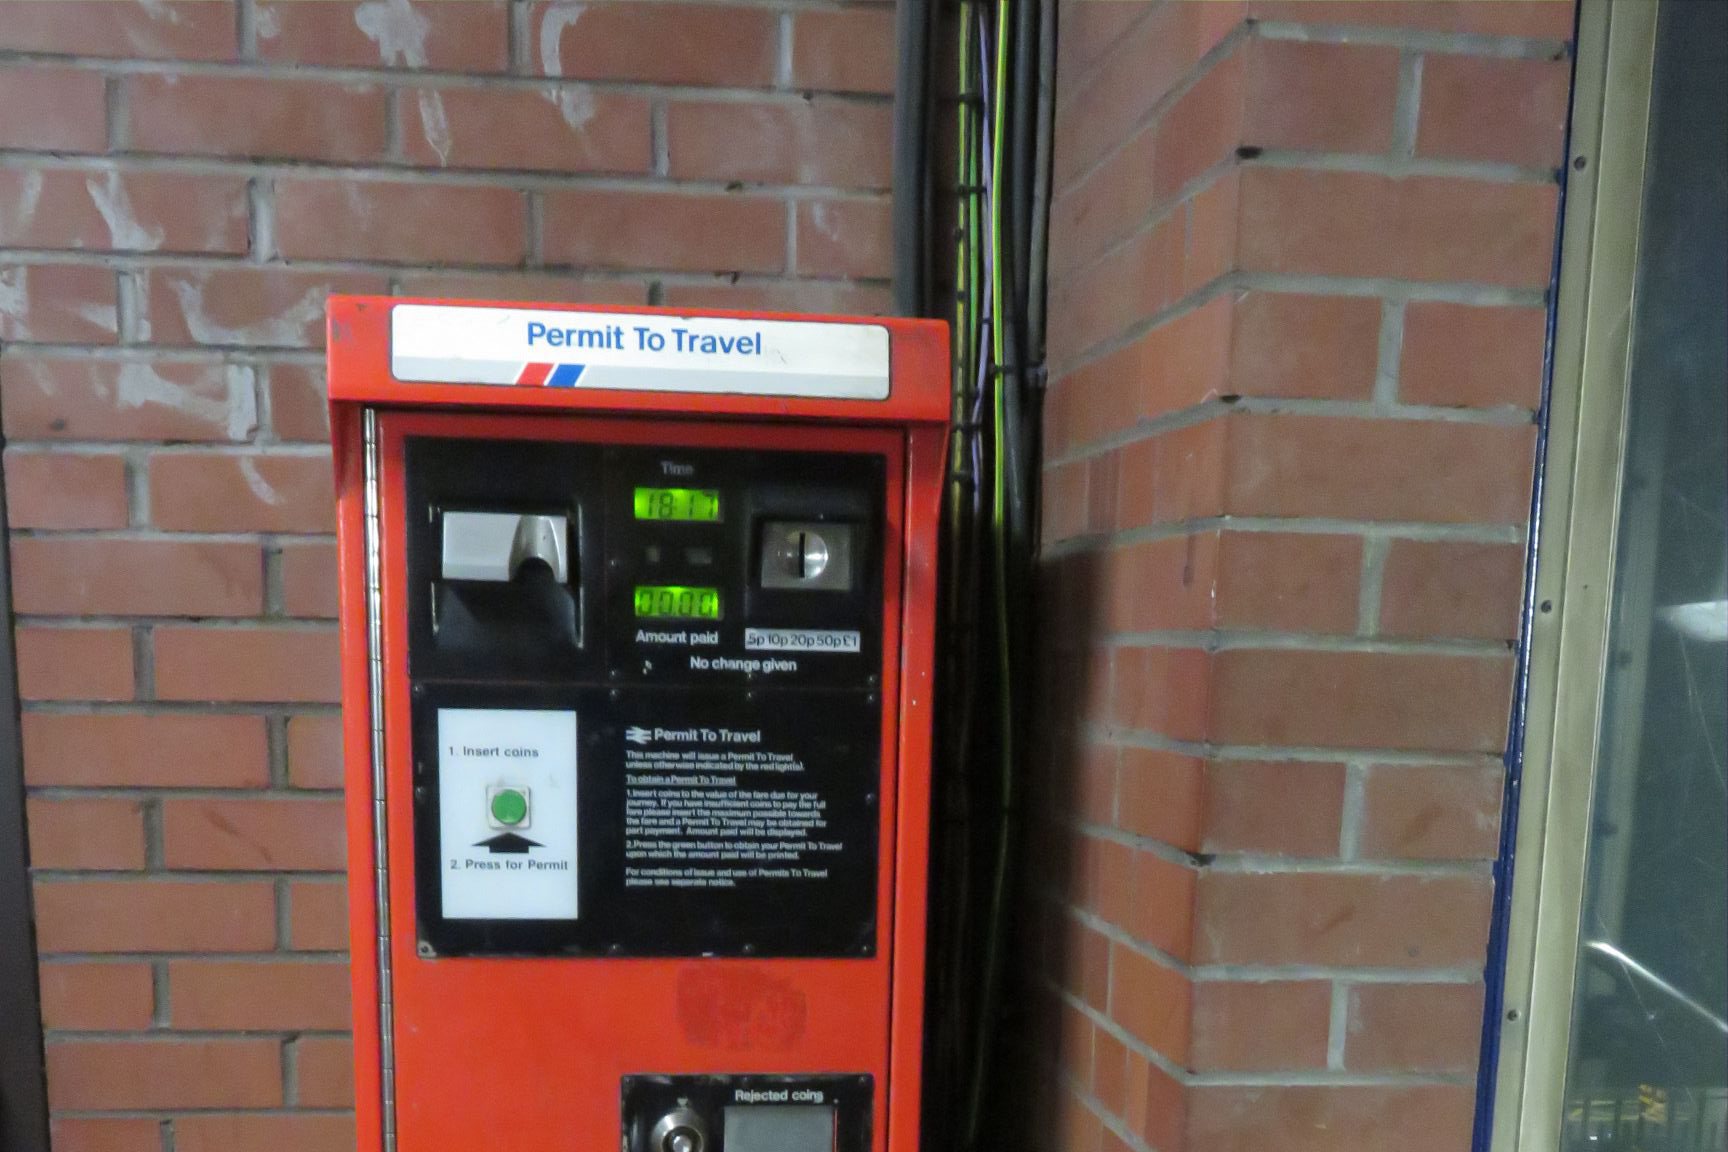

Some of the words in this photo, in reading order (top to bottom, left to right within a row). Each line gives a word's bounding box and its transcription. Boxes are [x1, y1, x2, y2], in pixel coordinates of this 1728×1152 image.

[527, 322, 624, 350] Permit
[633, 327, 665, 351] To
[671, 328, 761, 355] Travel
[660, 461, 693, 476] Time
[635, 629, 687, 643] Amount
[690, 631, 719, 646] paid
[748, 633, 765, 646] 5p
[768, 633, 788, 647] 10p
[790, 633, 815, 648] 20p
[816, 634, 841, 649] 50p
[843, 635, 857, 647] £1
[690, 656, 709, 669] No
[712, 657, 760, 673] change
[762, 657, 797, 673] given
[654, 728, 698, 741] Permit
[700, 728, 717, 742] To
[719, 729, 760, 742] Travel
[463, 745, 500, 757] Insert
[504, 746, 539, 758] coins
[728, 752, 754, 761] Permit
[756, 752, 766, 761] To
[768, 752, 793, 761] Travel
[671, 776, 698, 784] Permit
[450, 859, 461, 870] 2.
[465, 859, 501, 870] Press
[505, 859, 523, 870] for
[528, 859, 568, 870] Permit
[735, 1089, 788, 1102] Rejected
[791, 1089, 824, 1103] coins
